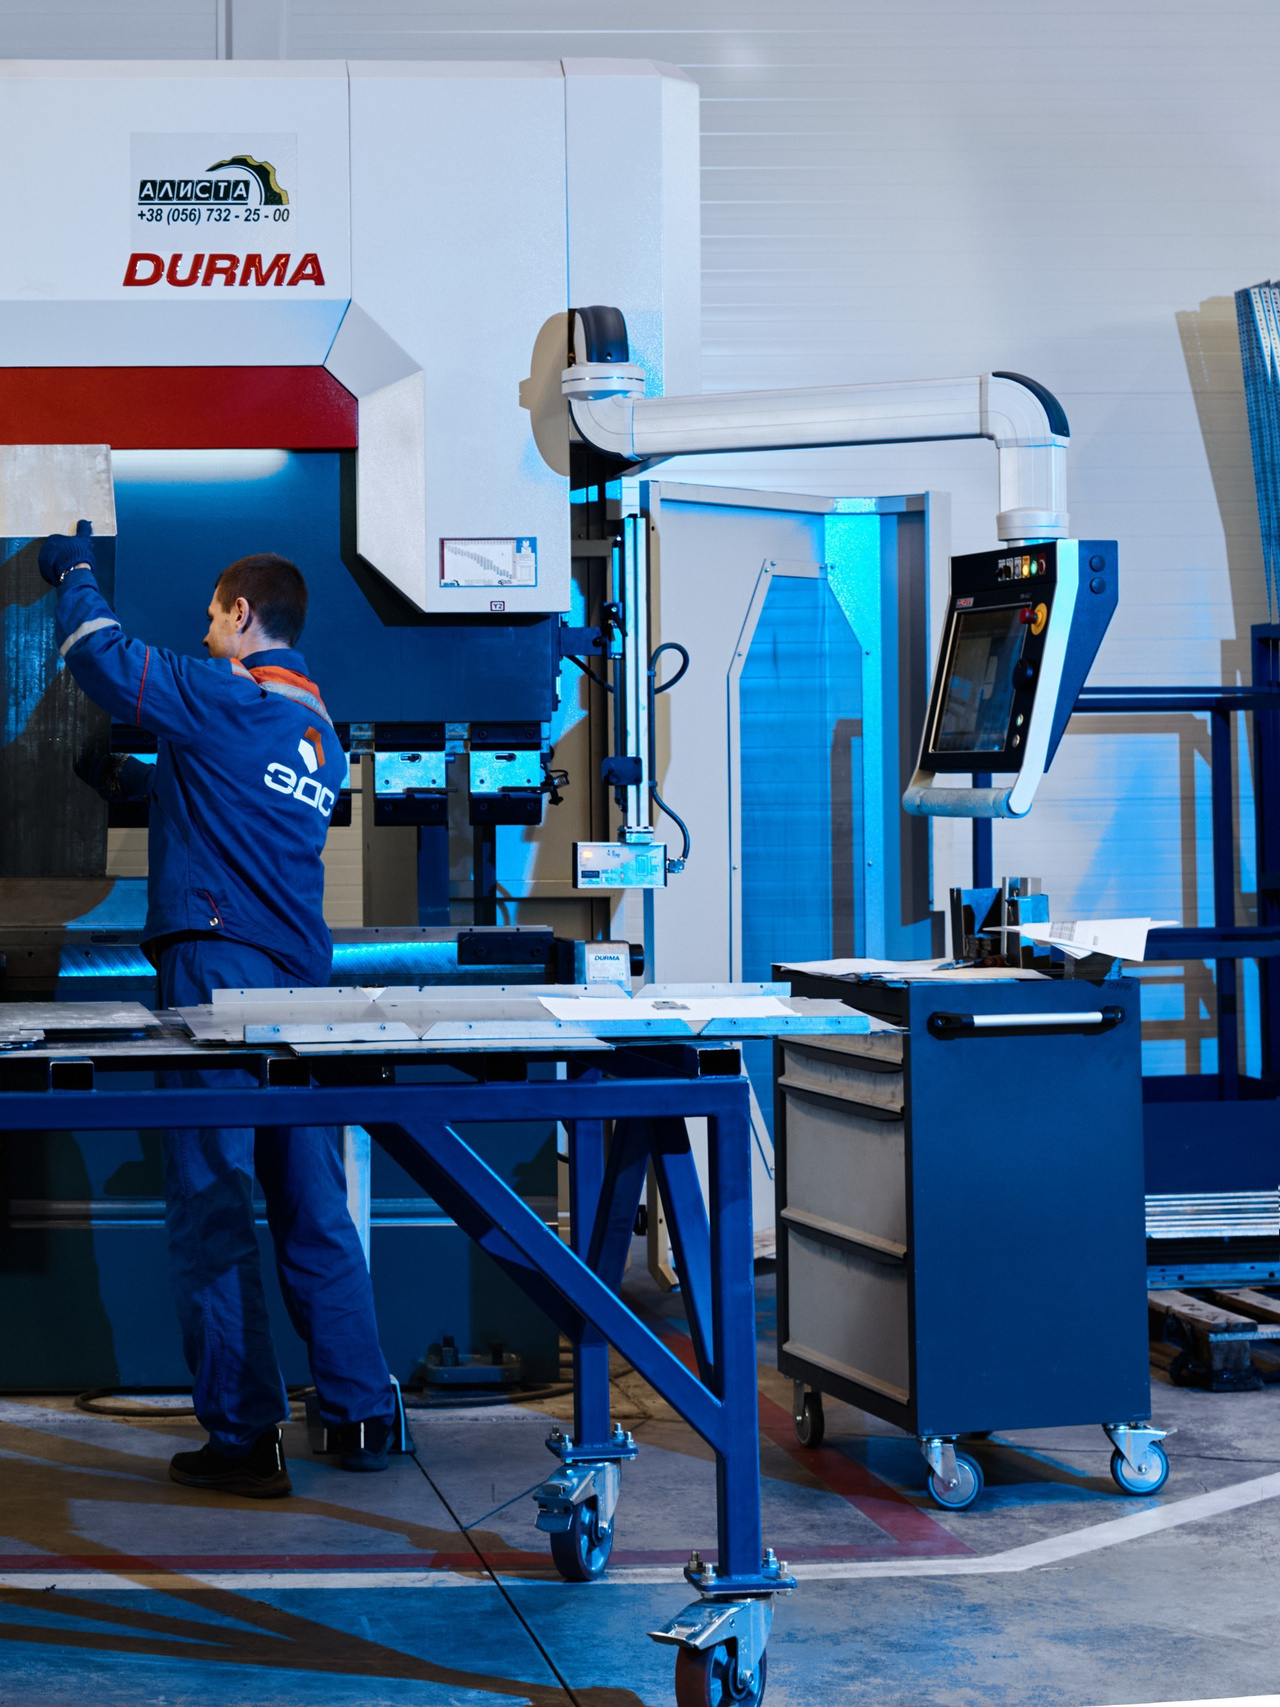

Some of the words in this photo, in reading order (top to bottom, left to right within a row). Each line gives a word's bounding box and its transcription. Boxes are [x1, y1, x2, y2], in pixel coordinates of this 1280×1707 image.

[139, 181, 249, 200] АЛИСТА
[138, 208, 163, 222] +38
[166, 208, 201, 226] (056)
[206, 208, 231, 222] 732
[244, 208, 261, 222] 25
[273, 208, 290, 222] 00
[122, 253, 326, 287] DURMA
